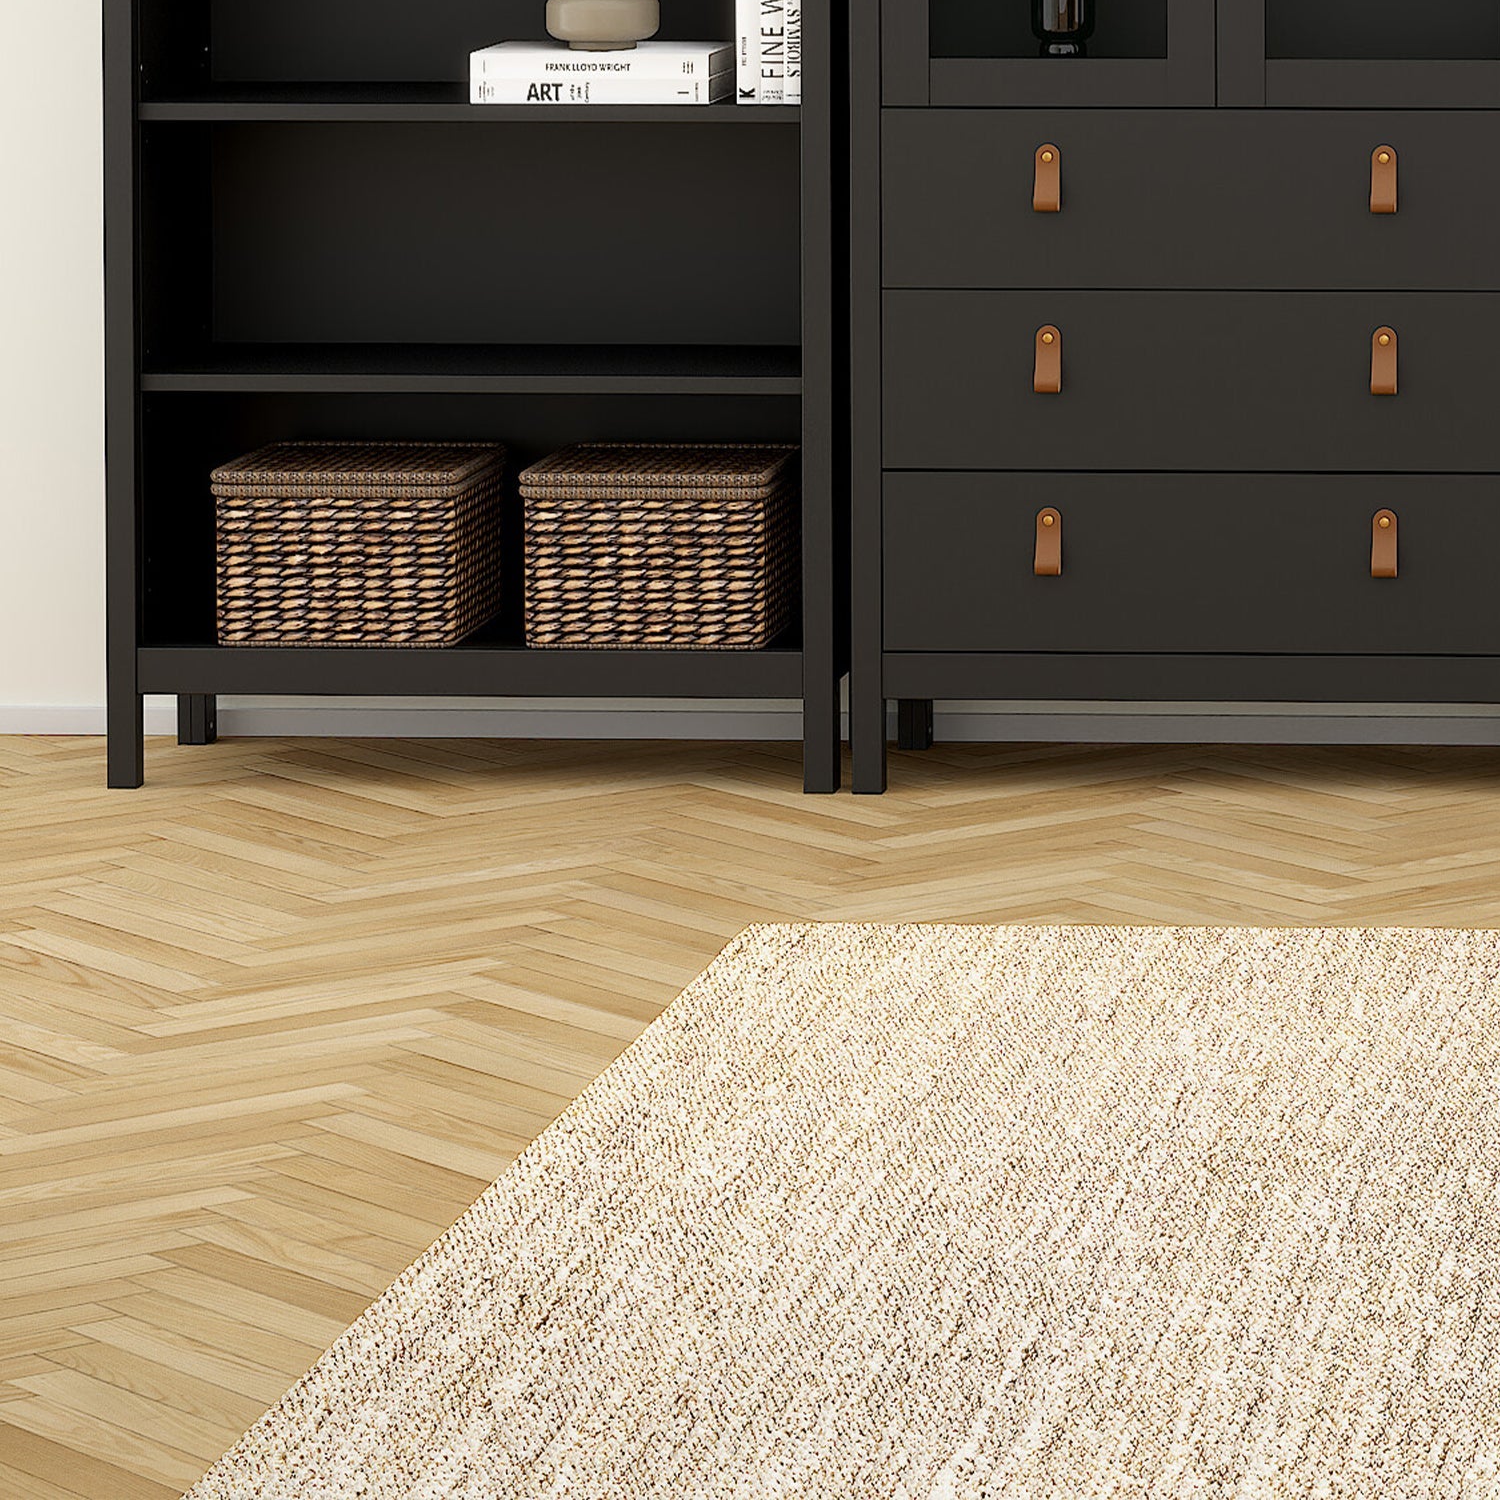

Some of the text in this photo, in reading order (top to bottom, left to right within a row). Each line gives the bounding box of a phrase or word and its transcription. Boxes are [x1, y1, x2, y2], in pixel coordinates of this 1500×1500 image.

[760, 26, 784, 79] FINE
[545, 63, 631, 72] FRANK LLOYD WRIGHT
[526, 82, 564, 102] ART
[738, 87, 756, 99] K
